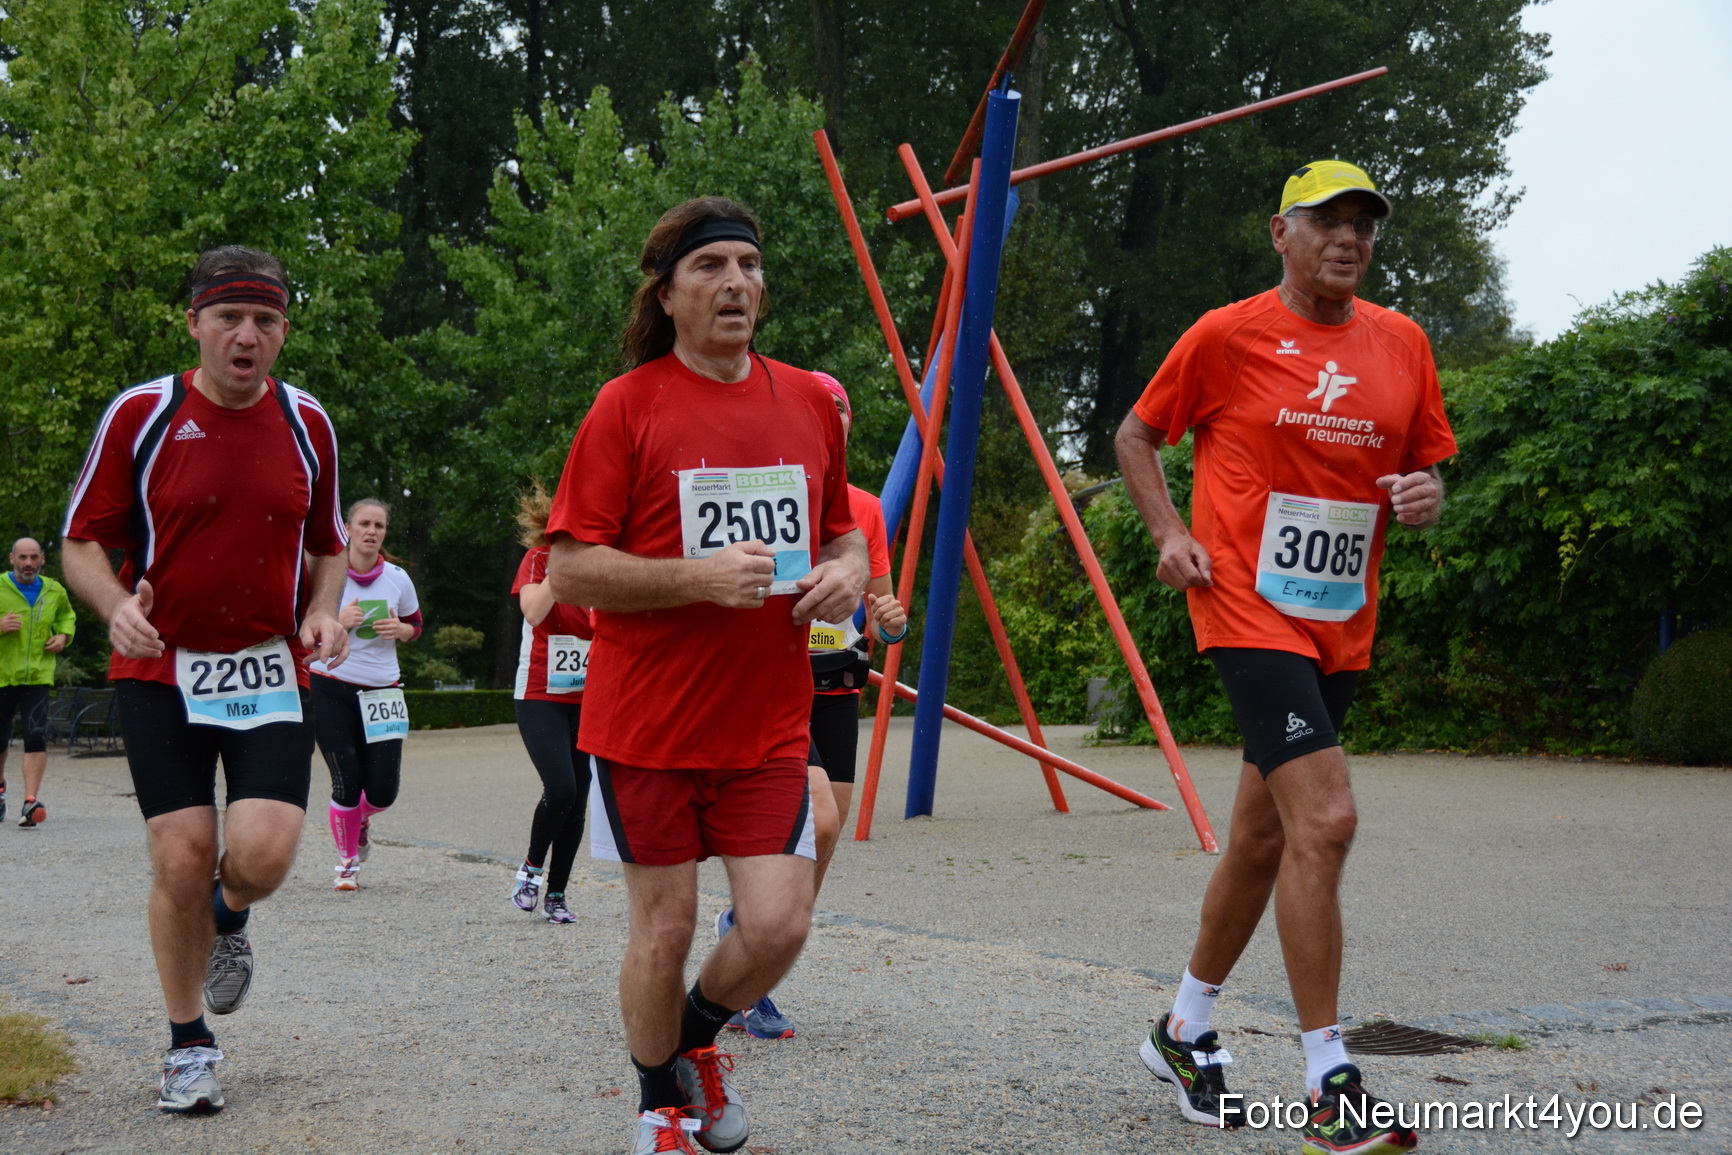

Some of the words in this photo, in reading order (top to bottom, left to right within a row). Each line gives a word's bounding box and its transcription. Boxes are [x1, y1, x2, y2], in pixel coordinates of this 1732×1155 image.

[1275, 408, 1374, 432] funrunners
[174, 432, 206, 440] adidas
[1306, 428, 1385, 449] neumarkt
[692, 484, 731, 493] NeuerMarkt
[736, 471, 796, 489] BOCK
[698, 497, 801, 549] 2503
[1278, 508, 1320, 520] NeuerMarkt
[1328, 506, 1369, 522] BOCK
[1274, 525, 1365, 577] 3085
[1282, 581, 1328, 601] Ernst
[811, 632, 835, 645] stina
[191, 654, 285, 695] 2205
[226, 702, 258, 717] Max
[367, 701, 405, 722] 2642
[1286, 727, 1313, 741] odlo
